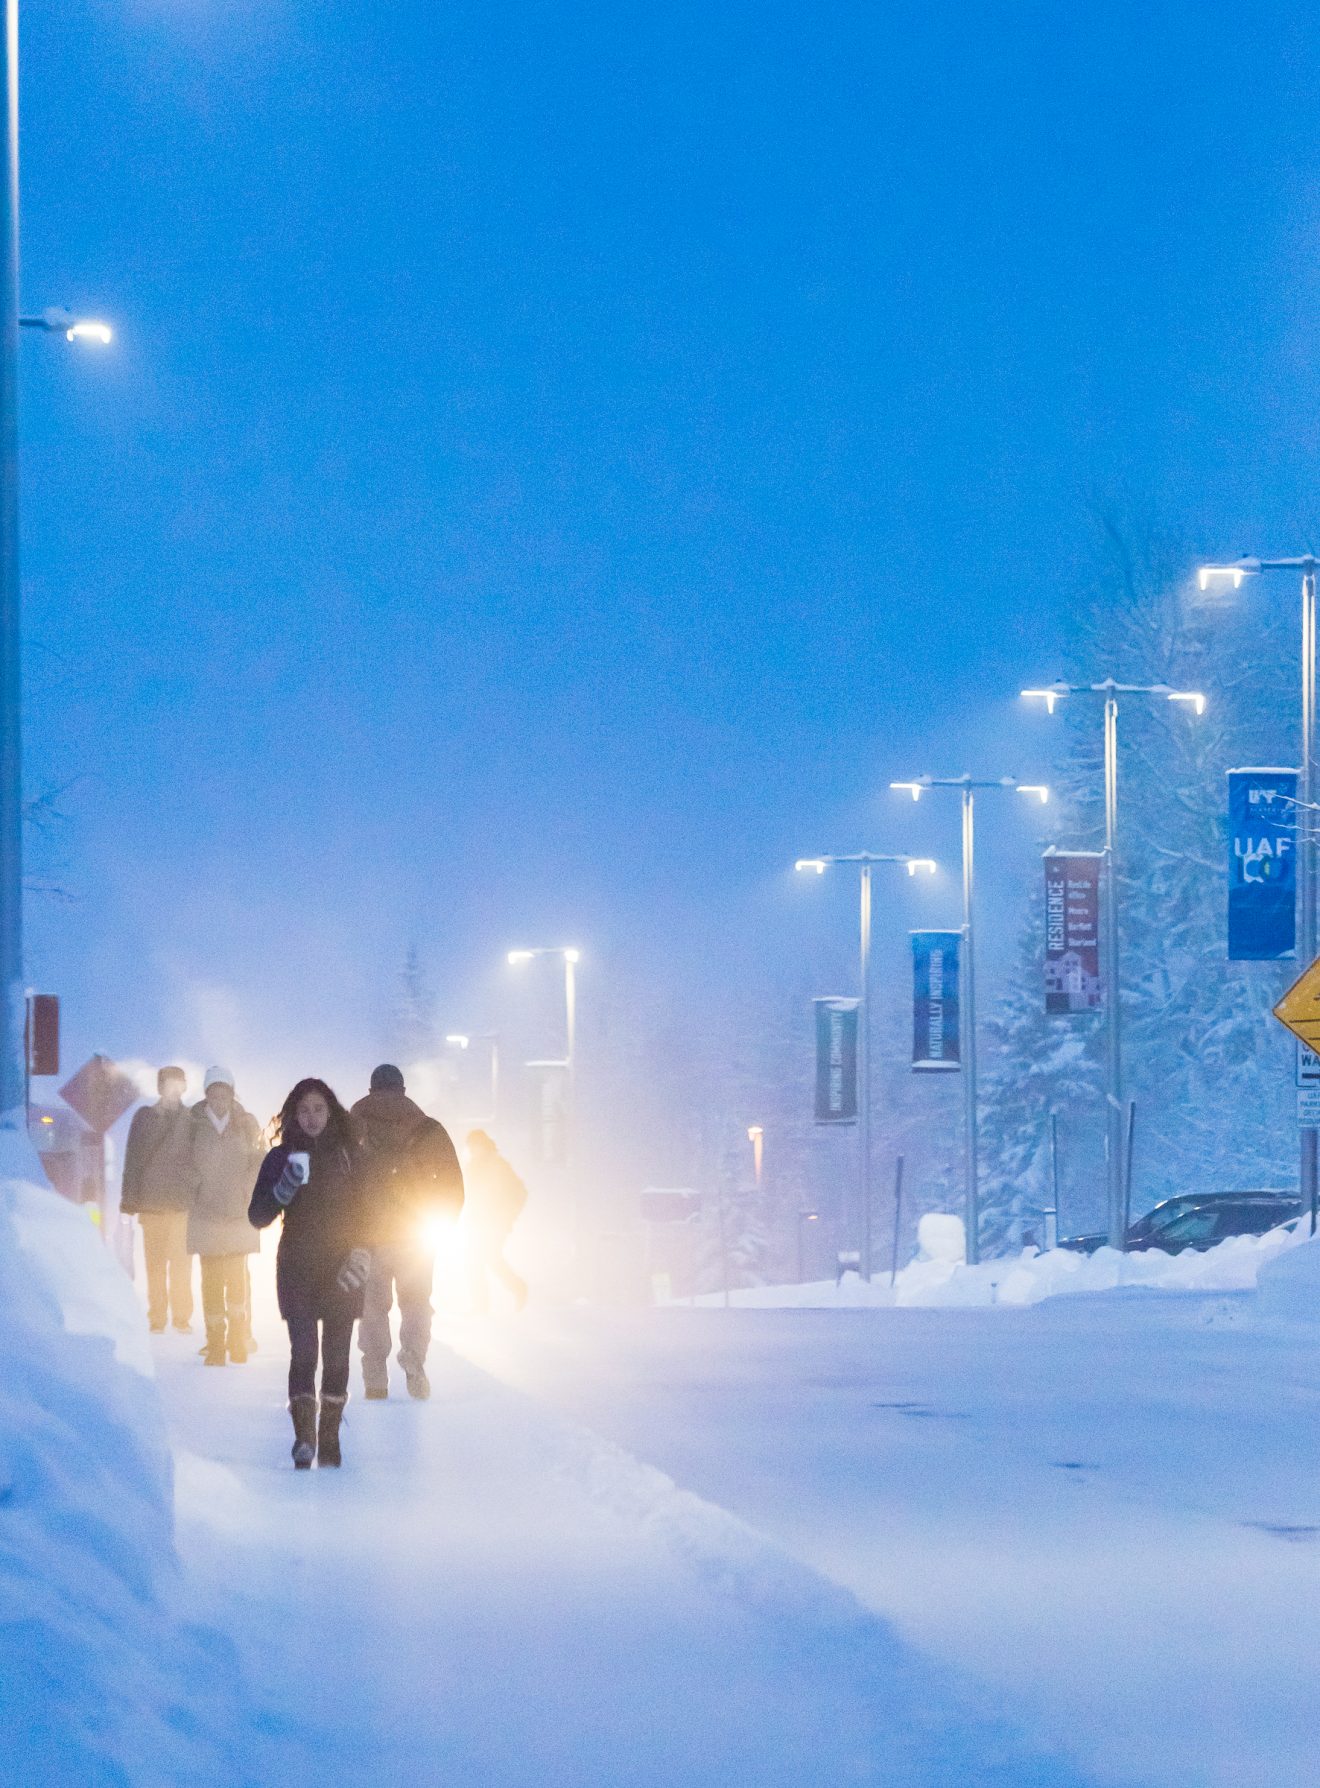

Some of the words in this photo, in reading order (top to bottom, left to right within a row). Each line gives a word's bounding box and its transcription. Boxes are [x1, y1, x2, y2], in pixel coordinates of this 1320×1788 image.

[1234, 837, 1292, 858] UAF
[1047, 880, 1065, 951] RESIDENCE
[930, 949, 944, 999] INSPIRING
[929, 1002, 944, 1058] NATURALLY
